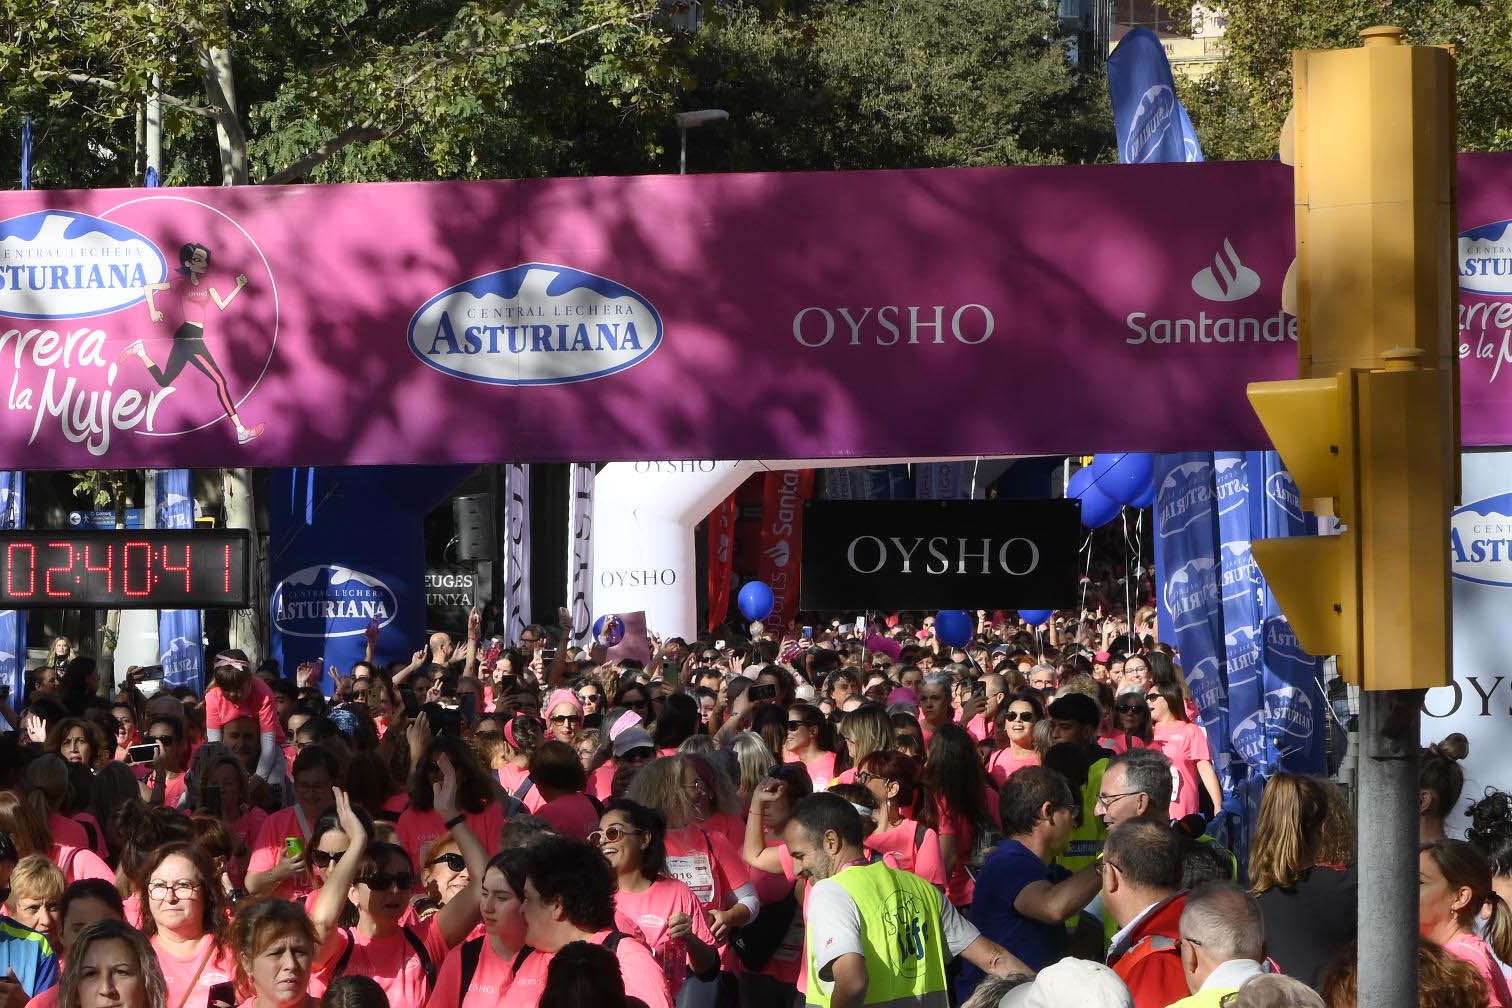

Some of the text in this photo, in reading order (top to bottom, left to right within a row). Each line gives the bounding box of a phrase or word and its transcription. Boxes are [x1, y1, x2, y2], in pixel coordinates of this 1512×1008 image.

[68, 247, 144, 258] LECHERA
[467, 305, 635, 318] CENTRAL LECHERA
[793, 303, 996, 348] OYSHO
[426, 310, 643, 355] ASTURIANA
[1477, 332, 1494, 358] la
[8, 368, 33, 410] la
[28, 363, 176, 456] Mujer
[7, 542, 232, 597] 02:40:41
[847, 535, 1041, 576] OYSHO
[601, 569, 677, 587] OYSHO
[276, 594, 389, 621] ASTURIANA
[1421, 675, 1512, 718] OY
